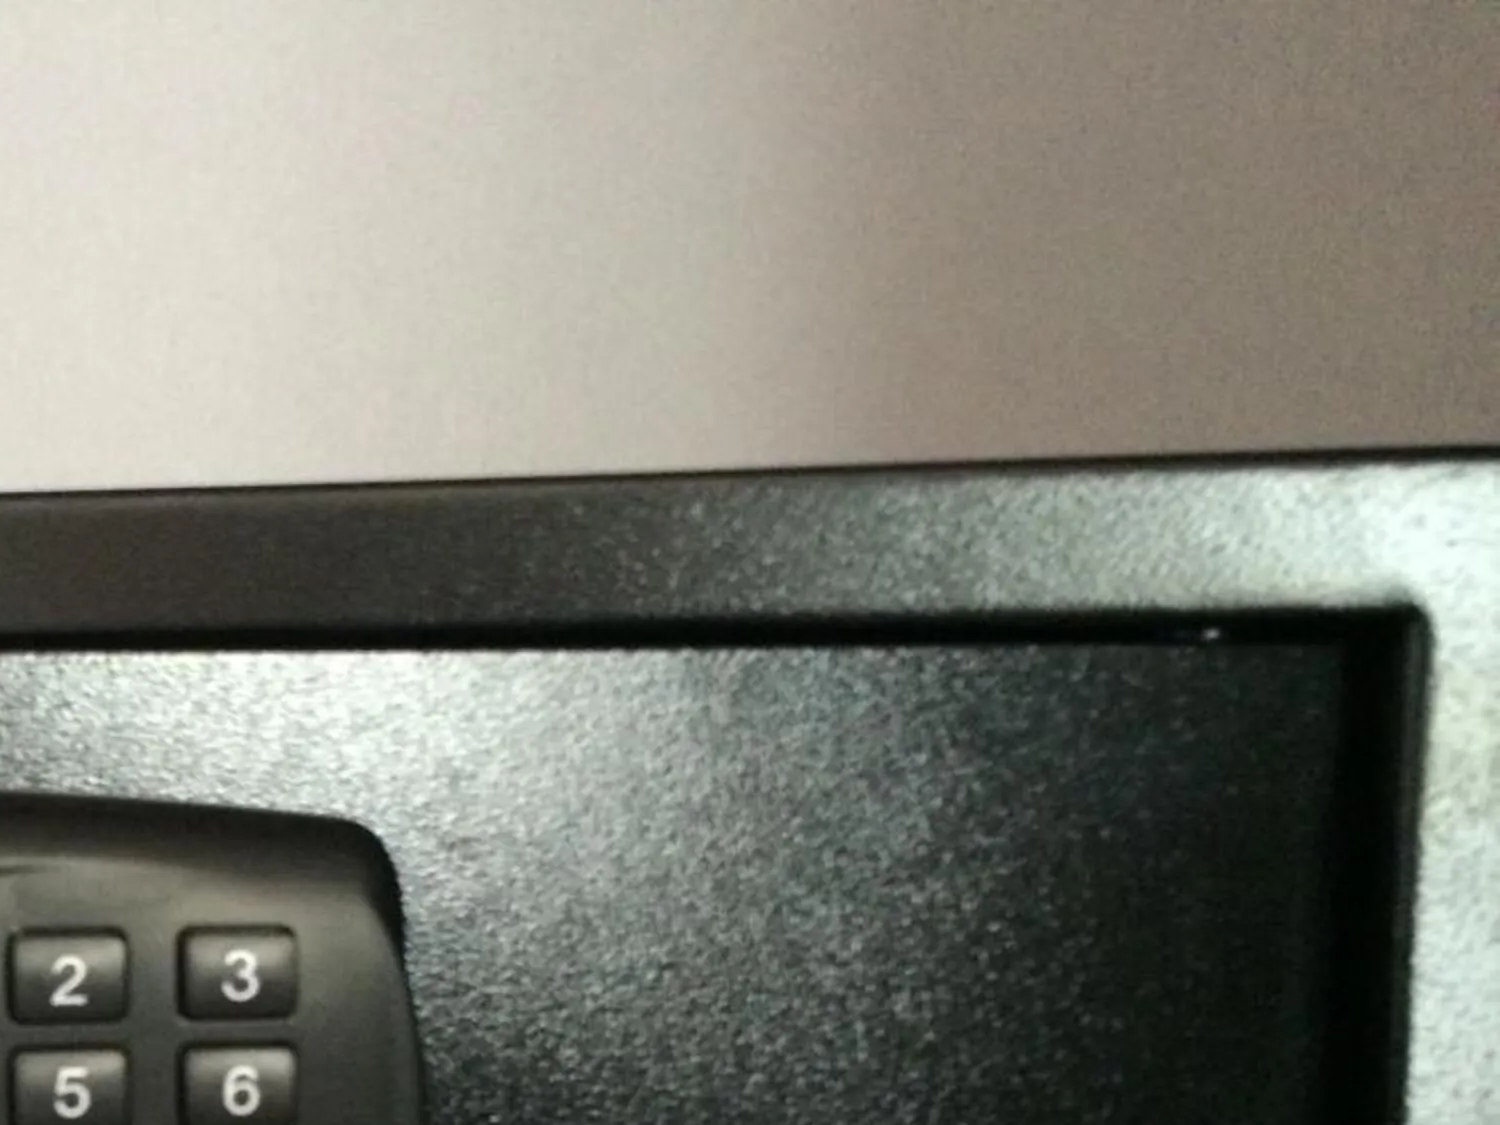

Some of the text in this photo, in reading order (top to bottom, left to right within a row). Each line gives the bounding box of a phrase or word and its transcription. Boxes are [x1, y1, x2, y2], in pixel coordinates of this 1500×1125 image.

[50, 955, 88, 1006] 2
[220, 949, 260, 1002] 3
[52, 1066, 92, 1118] 5
[221, 1065, 261, 1116] 6
